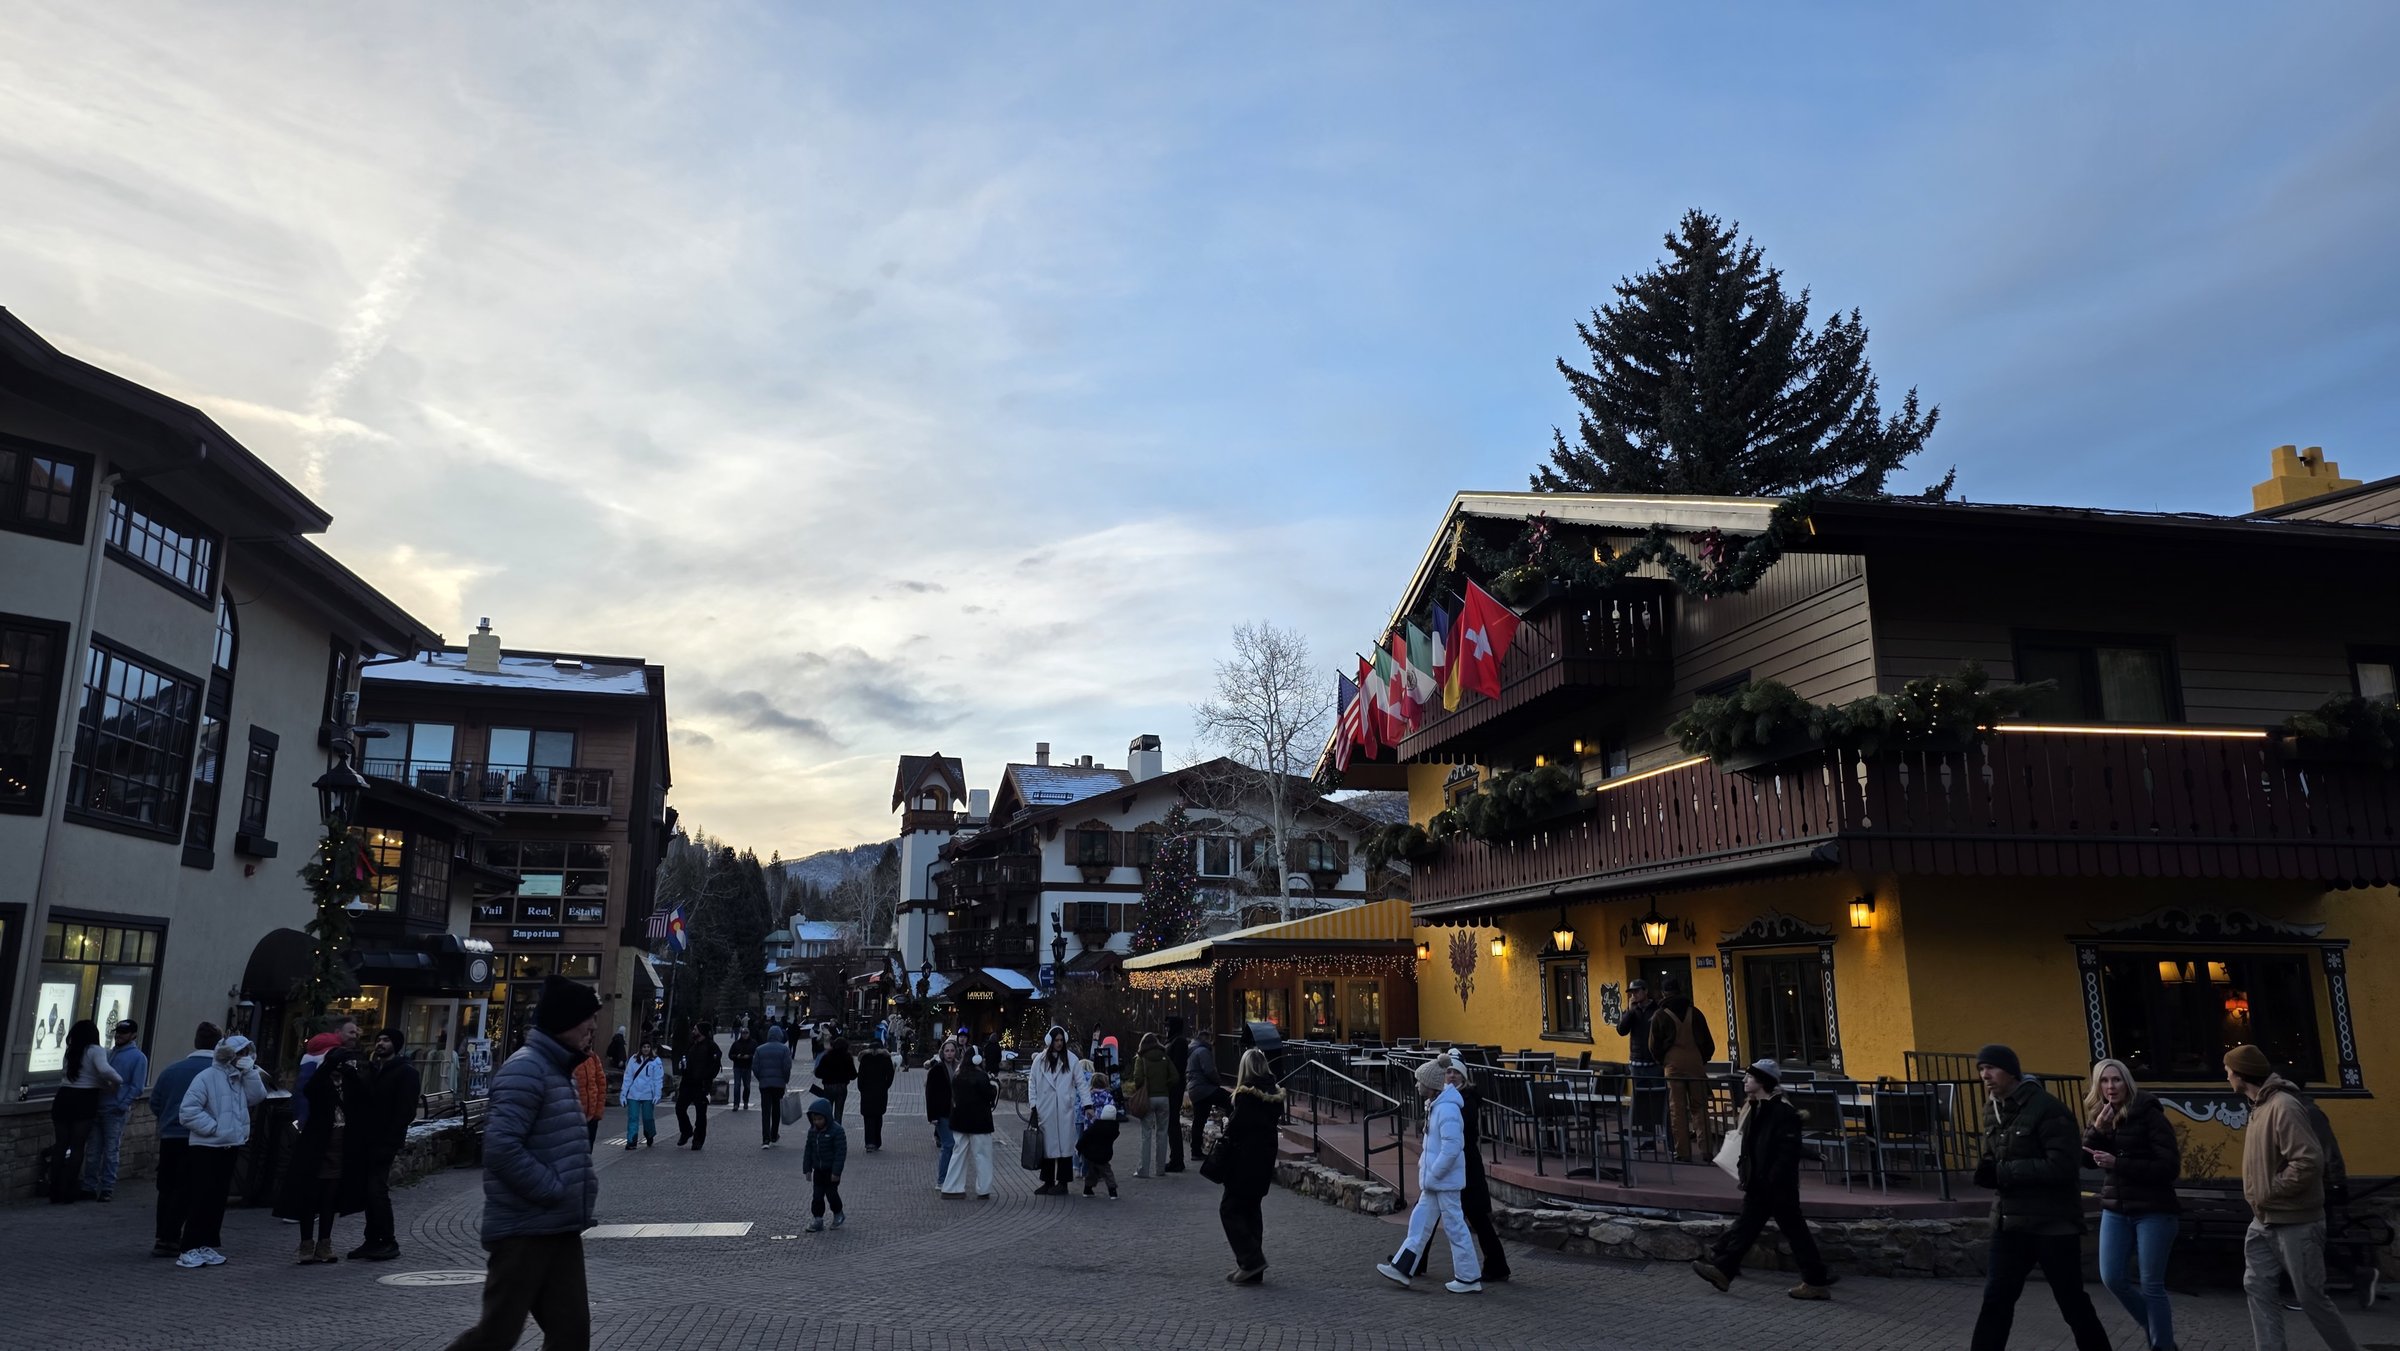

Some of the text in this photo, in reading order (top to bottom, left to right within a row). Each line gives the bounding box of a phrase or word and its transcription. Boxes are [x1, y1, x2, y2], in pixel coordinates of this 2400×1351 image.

[480, 905, 602, 916] Vail Real Estate
[512, 929, 560, 939] Emporium
